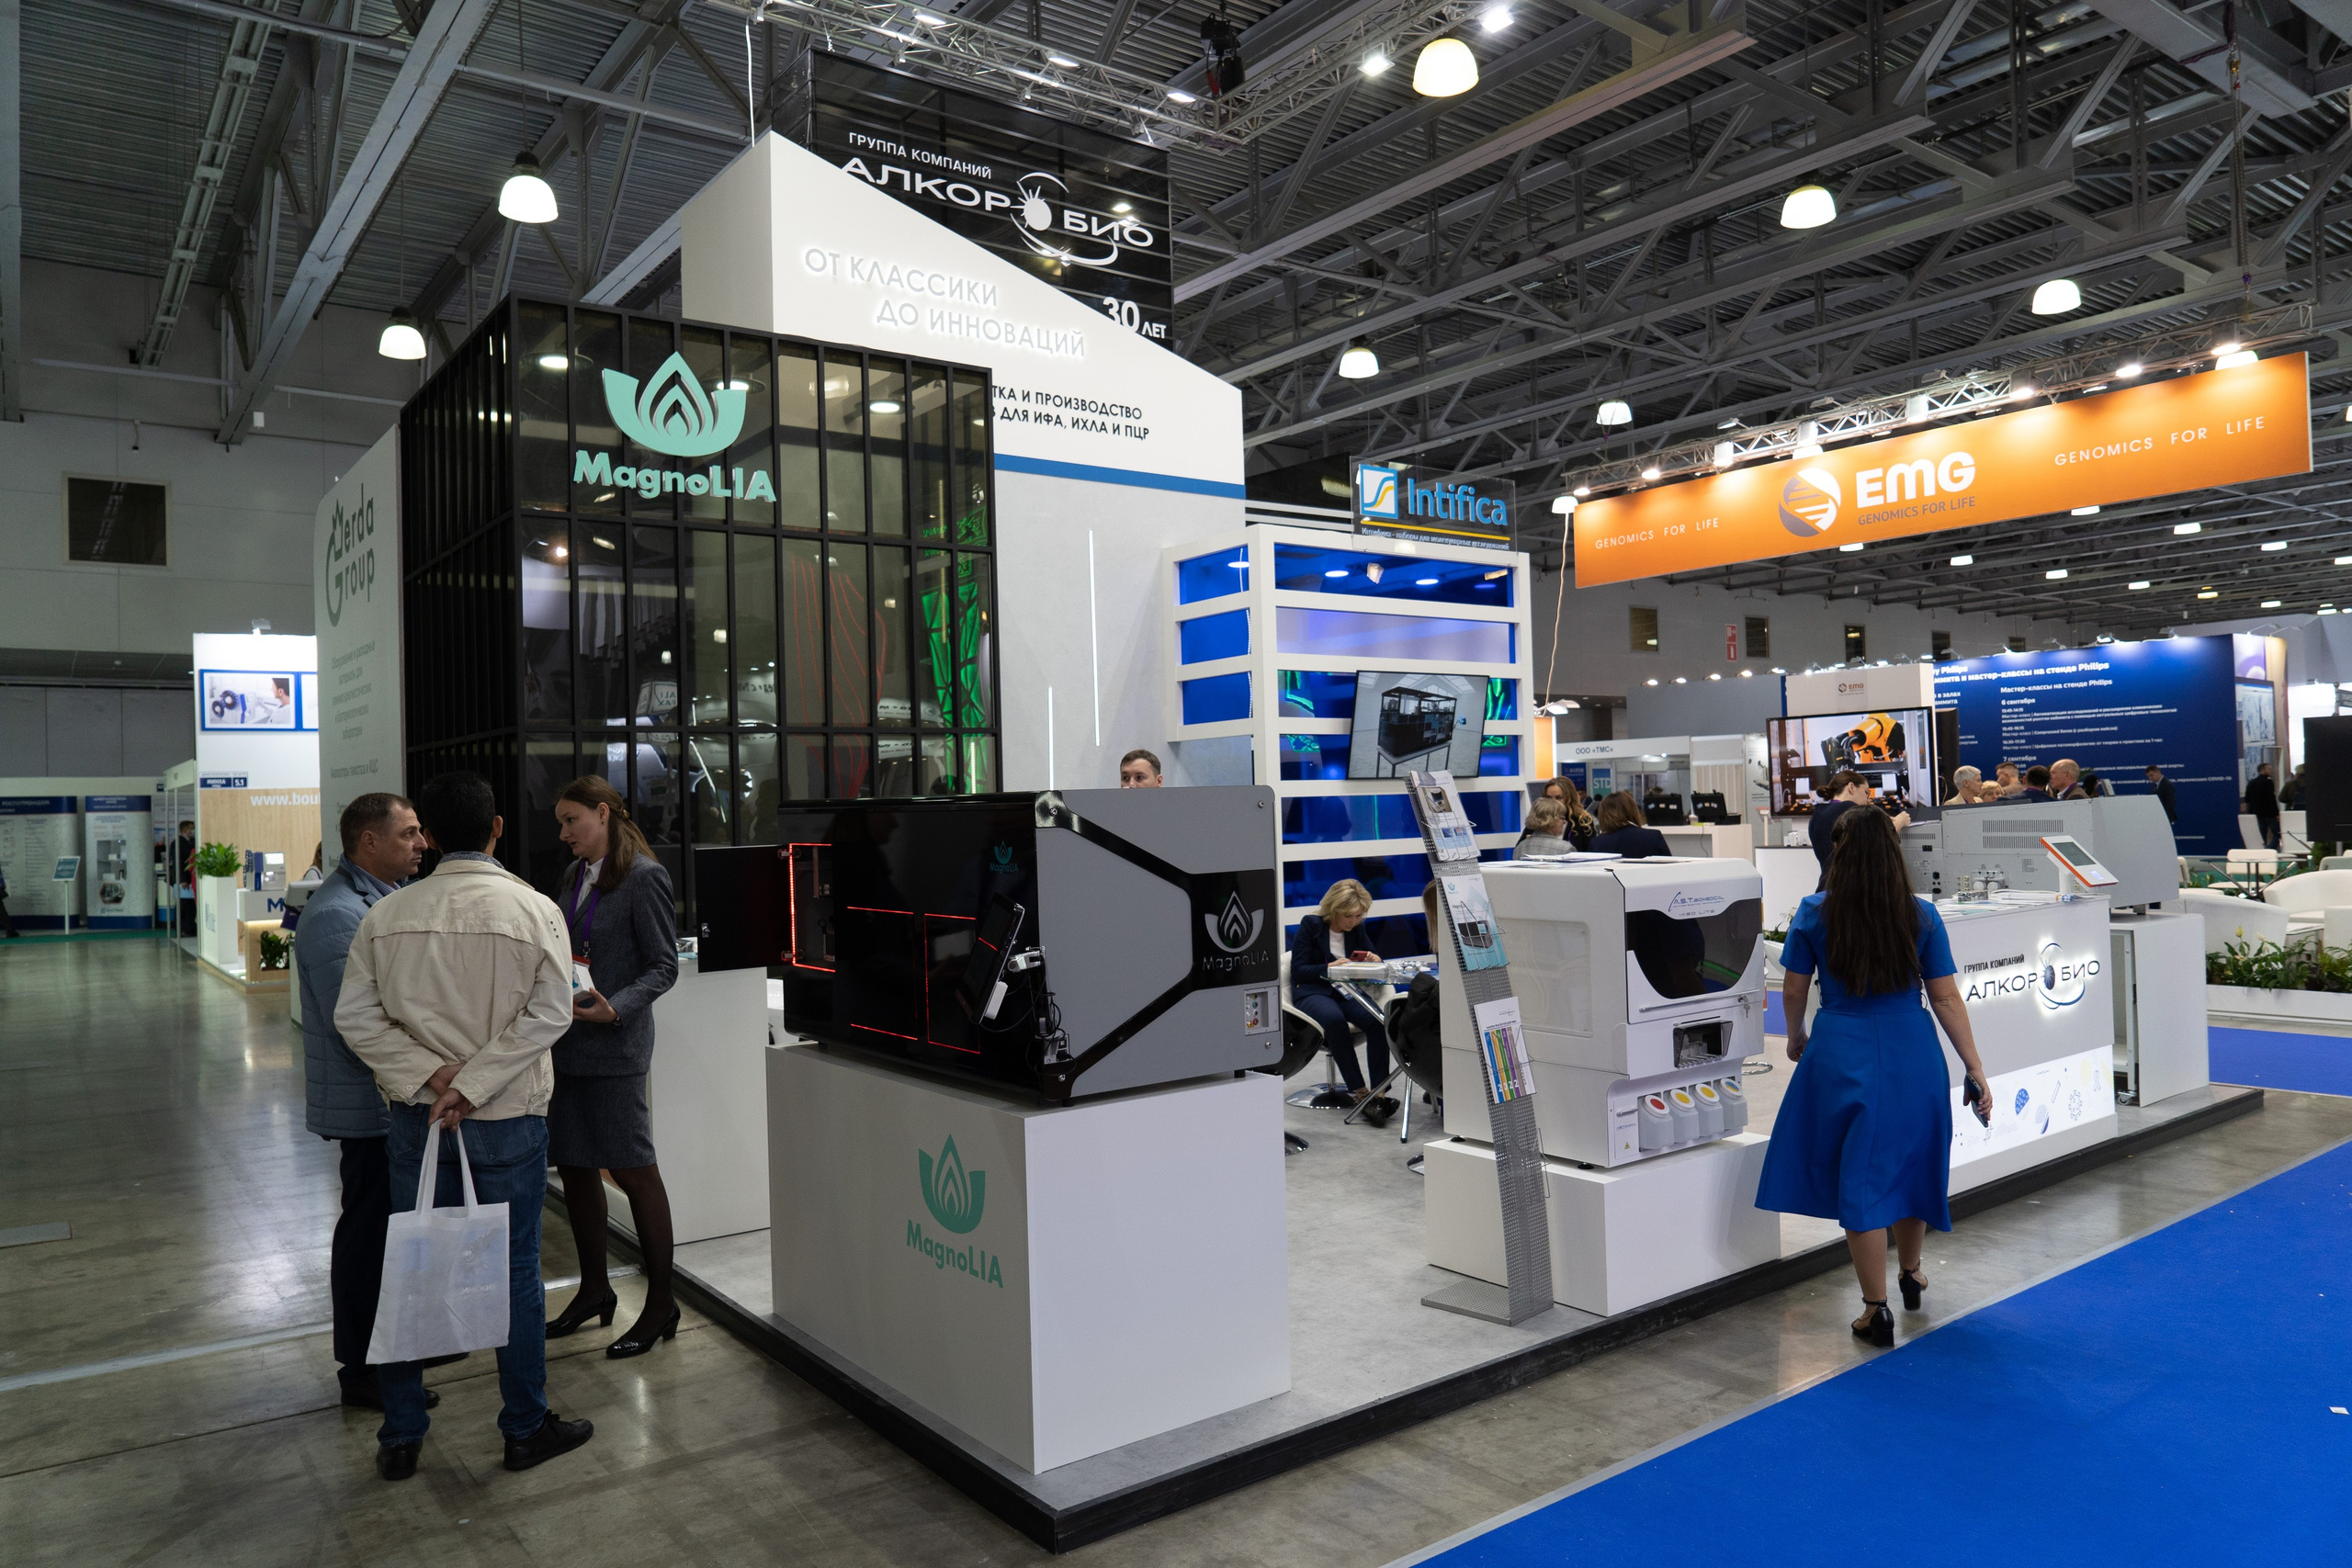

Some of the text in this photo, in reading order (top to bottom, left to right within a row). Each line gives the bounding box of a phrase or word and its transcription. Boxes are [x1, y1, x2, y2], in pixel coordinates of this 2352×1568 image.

[849, 131, 992, 179] ГРУППА КОМПАНИЙ
[841, 157, 1154, 246] АЛКОР БИО
[805, 247, 999, 307] ОТ КЛАССИКИ
[876, 299, 1086, 357] ДО ИННОВАЦИЙ
[1102, 296, 1167, 340] 30 ЛЕТ
[1022, 389, 1031, 403] И
[1035, 391, 1143, 420] ПРОИЗВОДСТВО
[1000, 406, 1029, 423] ДЛЯ
[1034, 411, 1068, 430] ИФА,
[1071, 416, 1109, 434] ИХЛА
[1113, 422, 1121, 436] И
[1125, 423, 1150, 441] ПЦР
[2054, 415, 2266, 467] GENOMICS FOR LIFE
[573, 449, 776, 503] MagnoLIA
[1856, 451, 1976, 509] EMG
[1407, 477, 1509, 526] Intifica
[1858, 495, 1976, 526] GENOMICS FOR LIFE
[1362, 527, 1391, 539] Интифика
[1396, 530, 1419, 541] наборы
[1419, 535, 1430, 543] для
[1595, 516, 1720, 550] GENOMICS FOR LIFE
[1941, 665, 1968, 675] Philips
[1962, 674, 1967, 682] и
[1968, 669, 2032, 682] мастер-классы
[2046, 666, 2076, 675] стенде
[2078, 661, 2109, 672] Philips
[2000, 683, 2052, 694] Мастер-классы
[2064, 681, 2087, 689] стенде
[2088, 678, 2113, 687] Philips
[2007, 697, 2036, 705] сентября
[2007, 754, 2037, 762] сентября
[1203, 950, 1272, 971] MagnoLIA
[1964, 953, 2025, 974] ГРУППА КОМПАНИЙ
[1966, 960, 2100, 1002] АЛКОР БИО
[906, 1219, 1004, 1289] MagnoLIA
